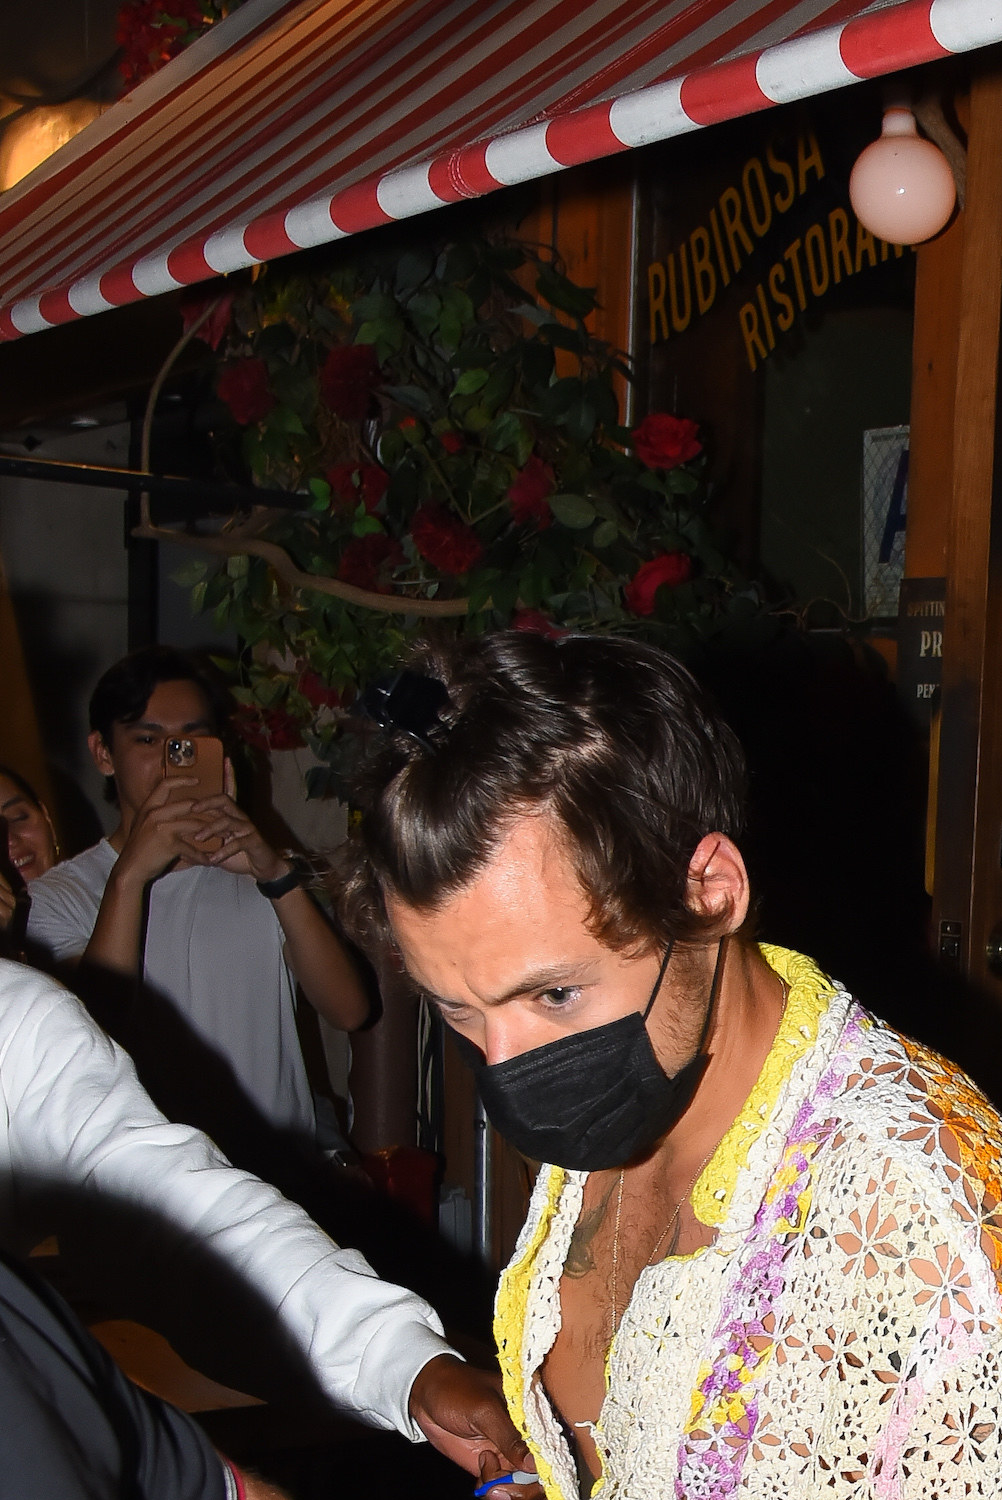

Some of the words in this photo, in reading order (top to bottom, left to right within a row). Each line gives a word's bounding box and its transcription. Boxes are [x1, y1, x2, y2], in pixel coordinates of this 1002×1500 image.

[647, 128, 826, 345] RUBIROSA
[739, 206, 916, 373] RISTORA
[916, 683, 940, 699] PEN
